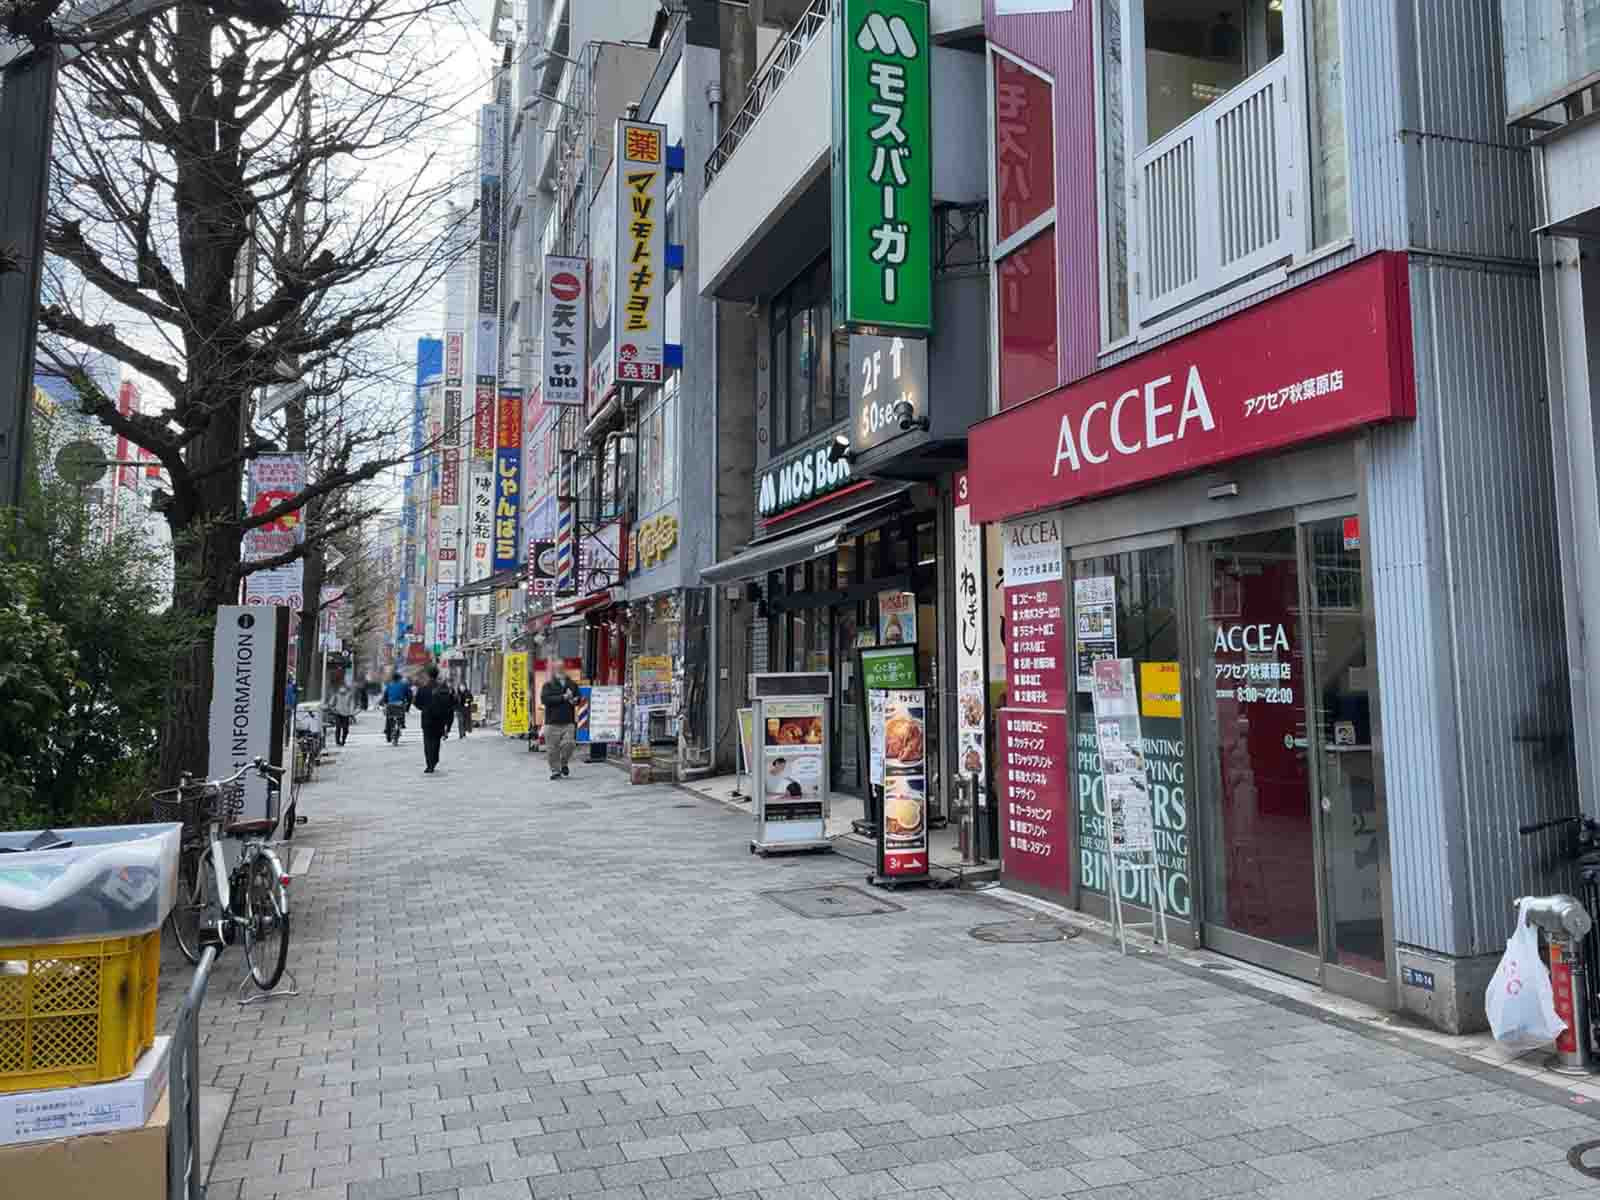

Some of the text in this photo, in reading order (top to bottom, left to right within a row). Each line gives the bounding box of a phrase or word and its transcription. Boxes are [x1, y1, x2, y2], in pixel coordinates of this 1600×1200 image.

[628, 127, 657, 161] 薬
[869, 63, 909, 302] モスバーガー
[626, 171, 657, 330] マツモトキヨシ
[549, 303, 578, 388] 天下一品
[623, 364, 657, 379] 免税
[862, 349, 881, 398] 2F
[1243, 370, 1344, 417] アクセア秋葉原店
[1052, 365, 1215, 477] ACCEA
[778, 453, 814, 505] MOS
[1011, 519, 1059, 547] ACCEA
[959, 566, 977, 657] ねぎし
[1214, 623, 1290, 653] ACCEA
[232, 634, 253, 757] INFORMATION
[1214, 662, 1291, 680] アクセア秋葉原店
[1081, 850, 1191, 915] BINDING
